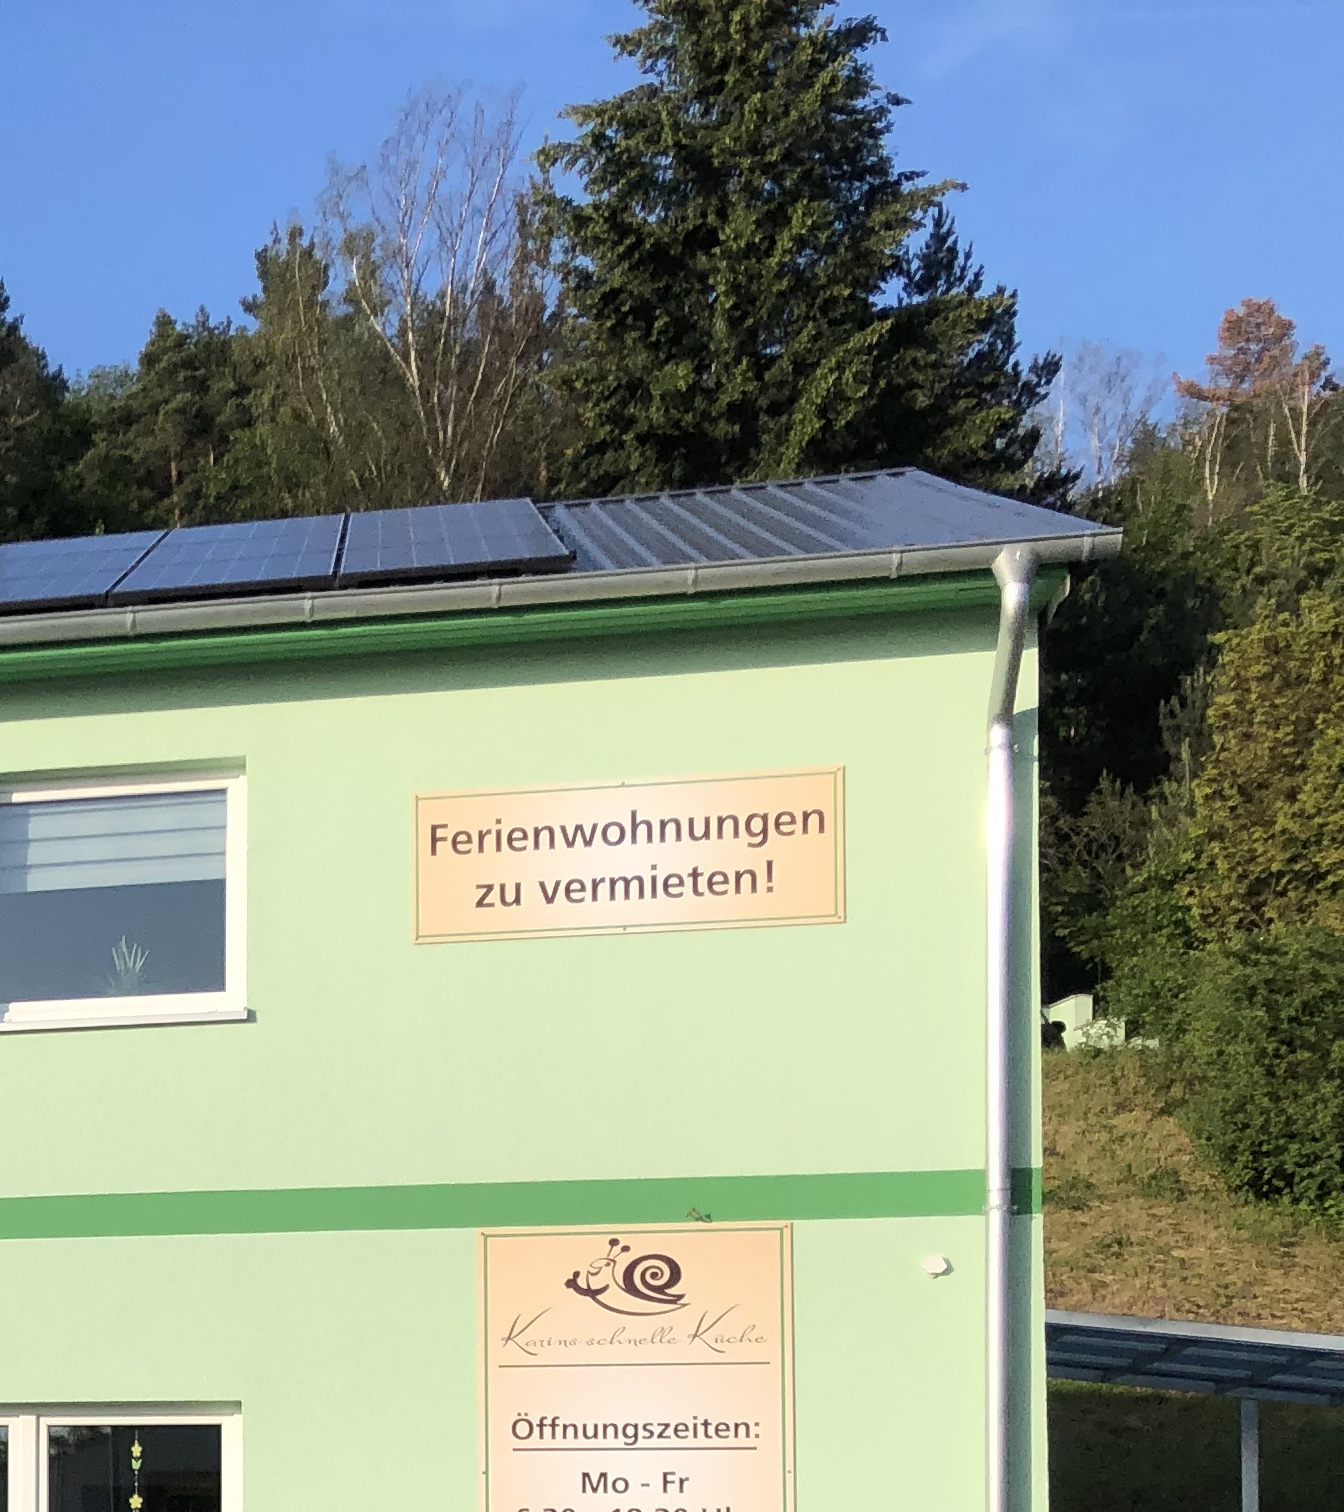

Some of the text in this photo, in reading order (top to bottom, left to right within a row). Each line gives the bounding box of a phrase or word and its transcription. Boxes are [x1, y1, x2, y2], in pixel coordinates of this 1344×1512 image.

[429, 807, 826, 857] Ferienwohnungen
[474, 859, 775, 909] zu vermieten!
[500, 1303, 768, 1356] Karins schnelle Küche
[511, 1411, 761, 1446] Öffnungszeiten:
[581, 1471, 630, 1495] Mo
[662, 1471, 690, 1495] Fr
